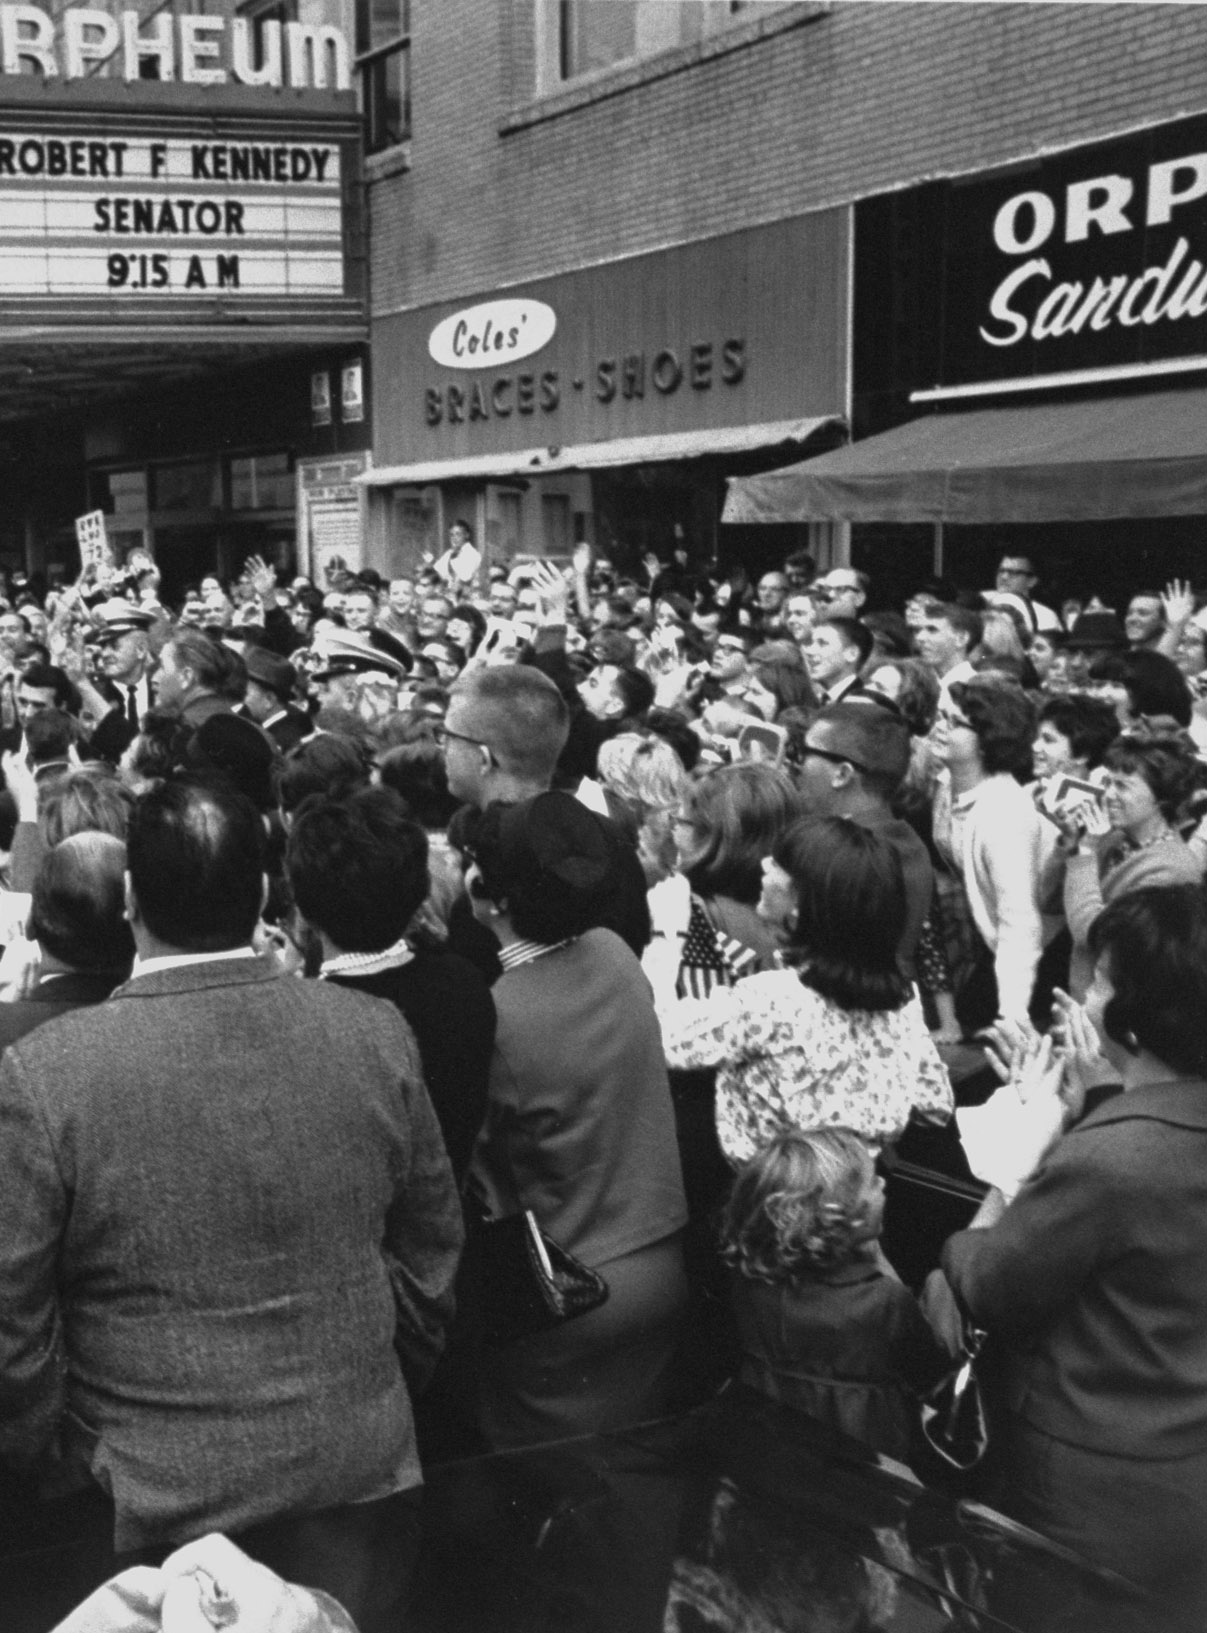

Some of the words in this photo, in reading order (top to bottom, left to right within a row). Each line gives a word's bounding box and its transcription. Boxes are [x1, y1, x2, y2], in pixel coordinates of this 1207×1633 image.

[149, 143, 168, 178] F
[191, 145, 331, 183] KENNEDY
[94, 198, 245, 234] SENATOR
[107, 253, 168, 288] 9:15
[185, 255, 207, 288] A
[216, 255, 240, 288] M
[452, 313, 528, 357] Coles'
[426, 371, 560, 427] BRACES
[596, 338, 747, 405] SHOES
